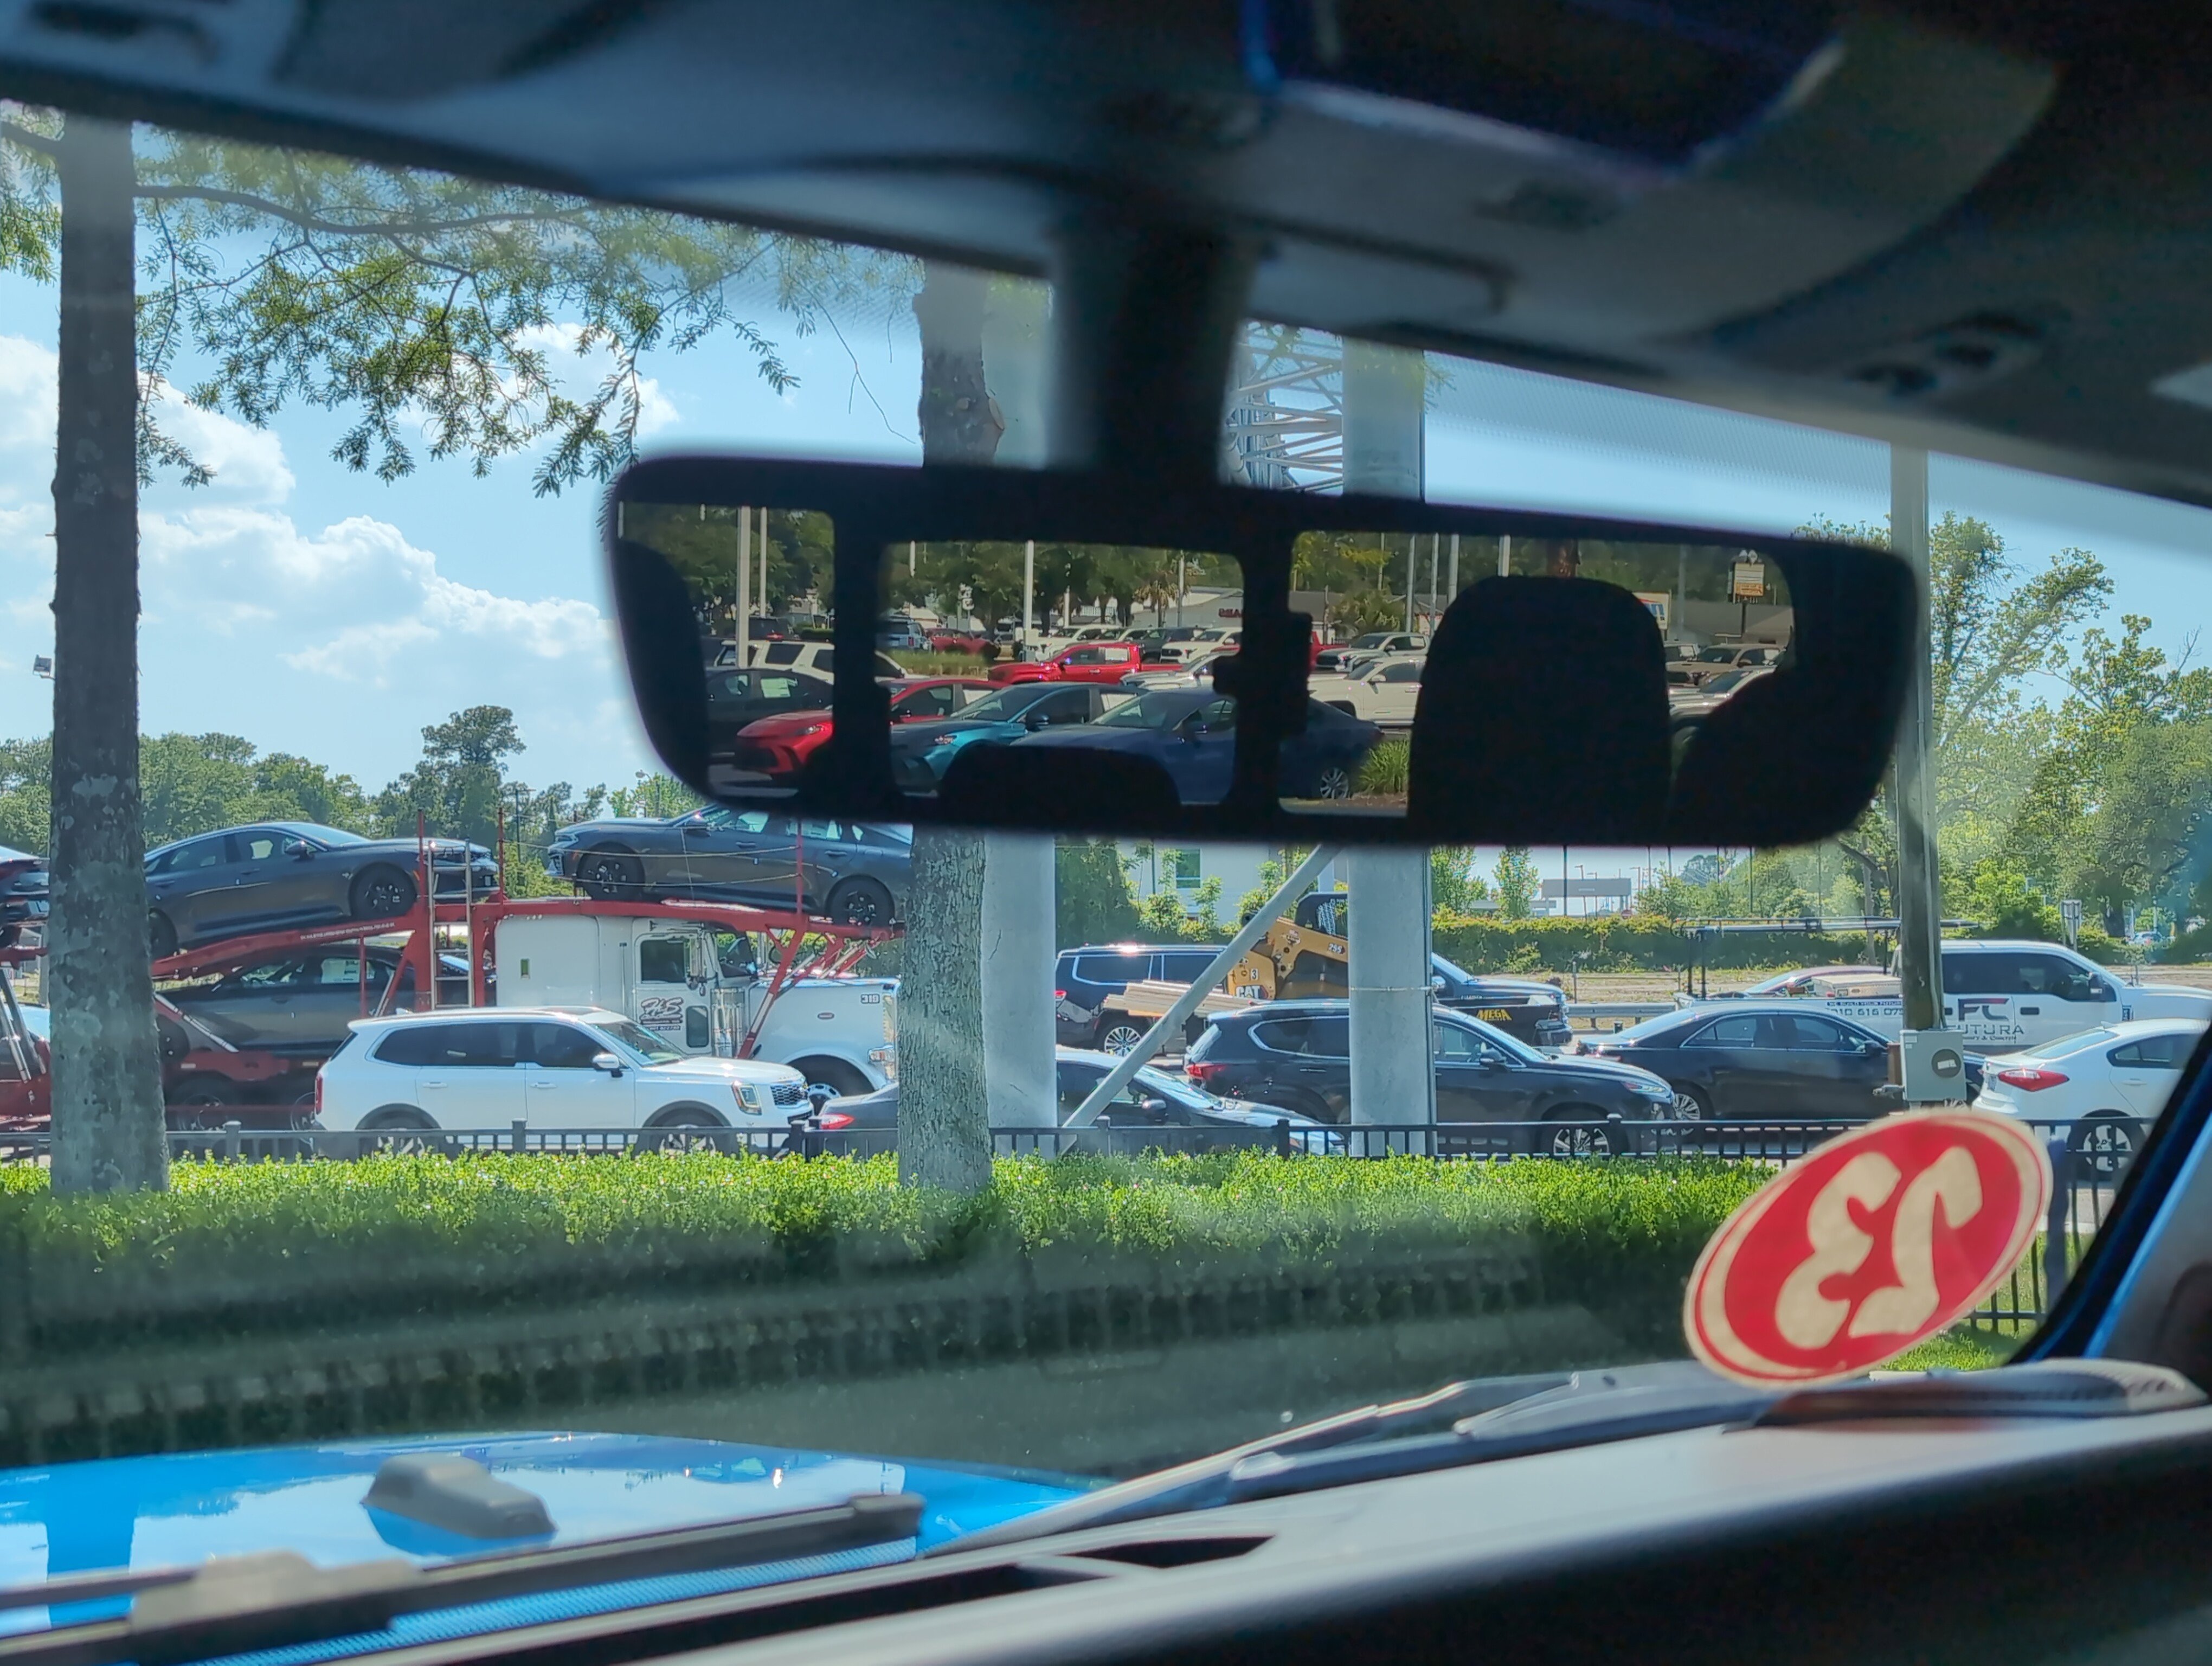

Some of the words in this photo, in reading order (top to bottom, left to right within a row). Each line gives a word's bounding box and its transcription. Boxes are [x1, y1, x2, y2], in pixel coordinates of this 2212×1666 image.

[1252, 969, 1257, 979] 3
[1236, 985, 1261, 998] CAT
[1476, 1009, 1513, 1021] MEGA
[1958, 998, 2009, 1021] FC
